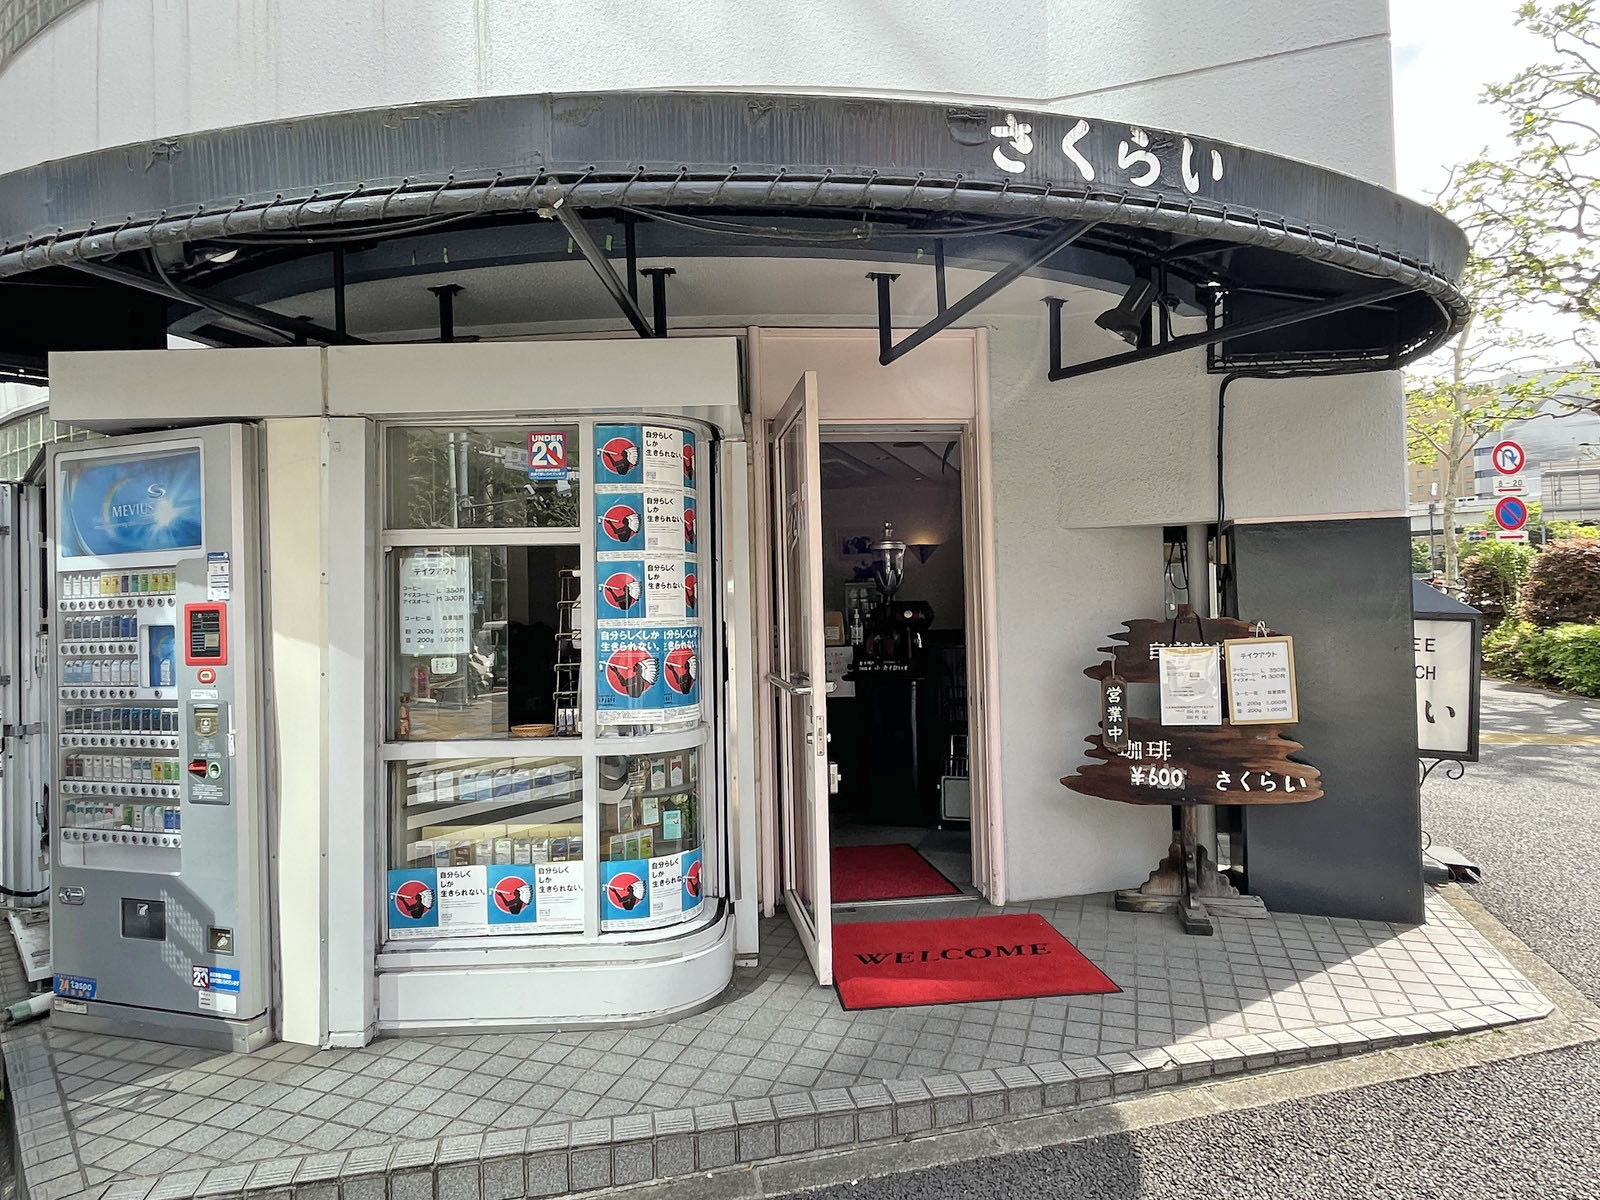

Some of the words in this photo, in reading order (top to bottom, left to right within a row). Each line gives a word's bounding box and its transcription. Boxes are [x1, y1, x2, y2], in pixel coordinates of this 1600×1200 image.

[990, 113, 1224, 194] さくらい
[531, 434, 563, 442] UNDER
[645, 431, 673, 440] 自分らしく
[531, 441, 563, 466] 20
[112, 502, 155, 518] MEVIUS
[413, 567, 457, 575] テイクアウト
[647, 564, 675, 572] 自分らしく
[601, 630, 660, 641] 自分らしくしか
[601, 641, 660, 652] 生きられない。
[1240, 651, 1277, 659] テイクアウト
[1415, 665, 1437, 680] CH
[1106, 685, 1123, 743] 営業中
[1117, 739, 1172, 761] 珈琲
[1131, 766, 1183, 786] ¥600
[1216, 771, 1307, 793] さくらい
[652, 858, 679, 869] 自分らしく
[440, 870, 471, 879] 自分らしく
[538, 866, 569, 874] 自分らしく
[652, 870, 664, 878] しか
[440, 888, 486, 897] 生きられない。
[538, 884, 583, 893] 生きられない。
[854, 942, 1052, 965] WELCOME
[70, 980, 93, 992] taspo
